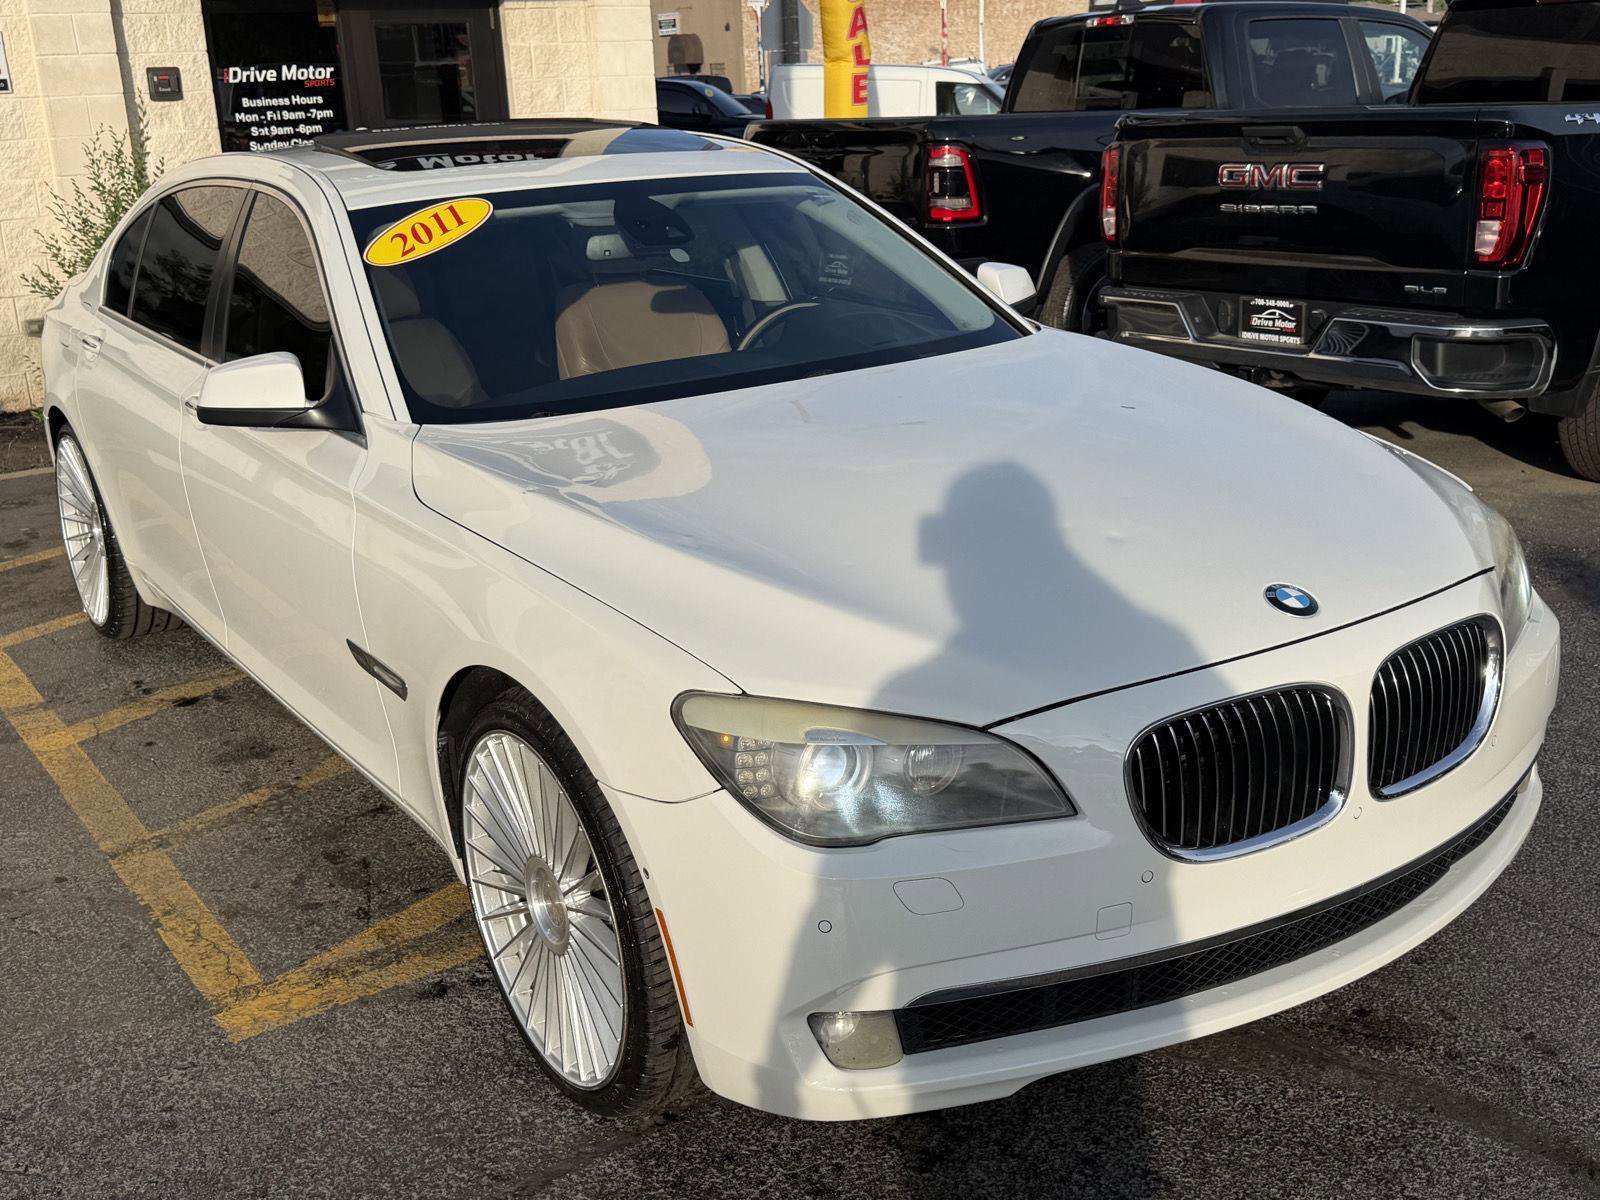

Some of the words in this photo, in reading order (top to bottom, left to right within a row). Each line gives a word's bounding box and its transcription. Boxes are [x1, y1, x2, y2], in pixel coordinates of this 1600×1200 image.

[848, 0, 871, 106] ALE
[281, 64, 334, 81] Motor
[304, 79, 336, 88] SPORTS
[241, 97, 290, 108] Business
[291, 95, 323, 105] Hours
[235, 113, 259, 123] Mon
[266, 111, 280, 121] Fri
[282, 111, 305, 120] 9am
[250, 126, 270, 137] Sat
[270, 126, 294, 136] 9am
[249, 140, 290, 152] Sunday
[1218, 163, 1325, 190] GMC
[1220, 203, 1318, 215] SIERRA
[390, 204, 469, 258] 2011
[1274, 318, 1297, 329] Motor
[1260, 333, 1279, 342] MOTOR
[1279, 335, 1301, 345] SPORTS
